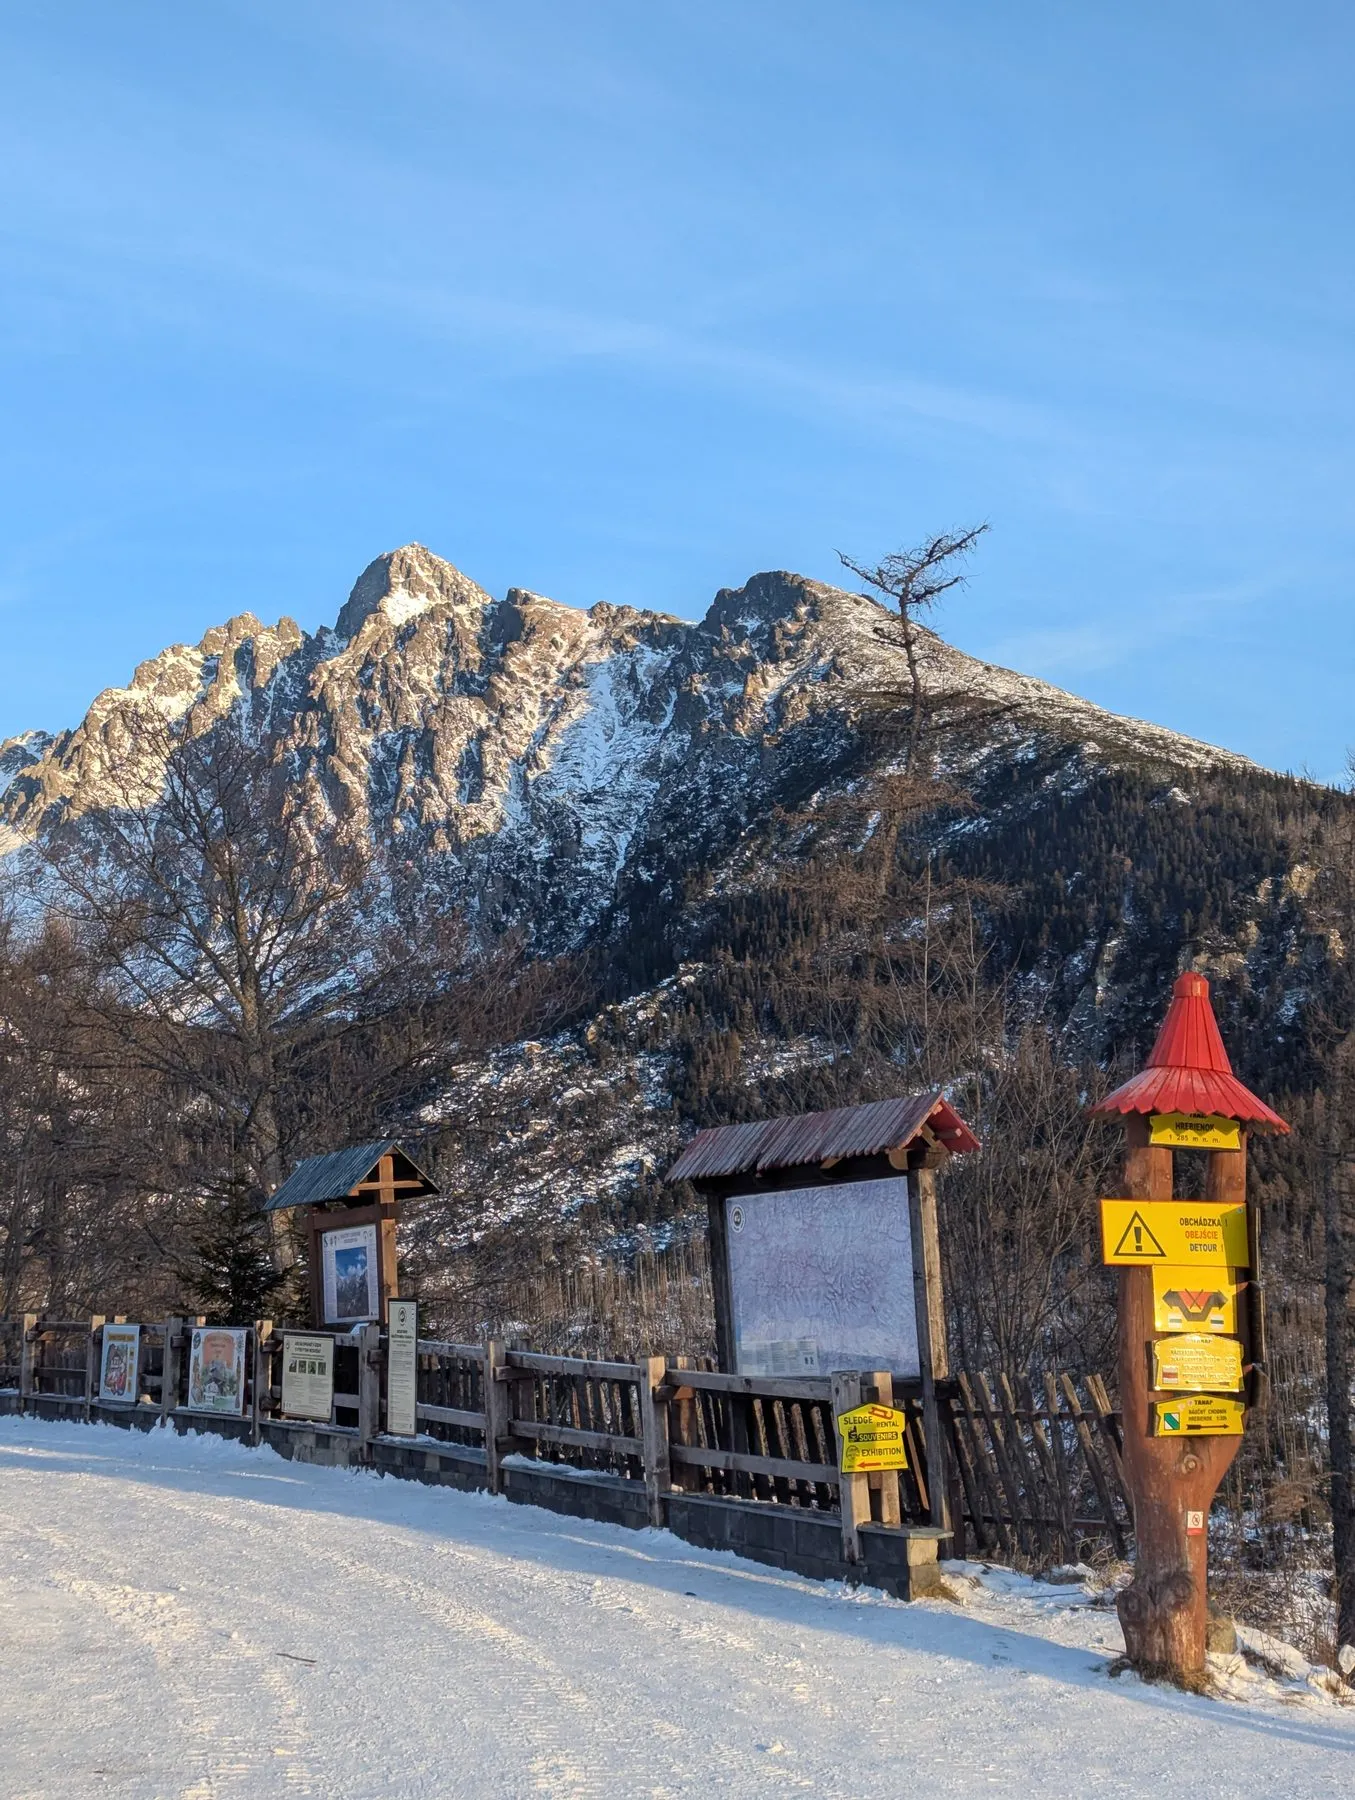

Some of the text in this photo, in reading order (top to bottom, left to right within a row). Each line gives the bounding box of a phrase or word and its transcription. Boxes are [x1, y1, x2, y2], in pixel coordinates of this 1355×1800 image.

[1177, 1134, 1188, 1142] 285
[1179, 1216, 1222, 1227] OBCHÁDZKA
[1185, 1229, 1218, 1239] OBEJŚCIE
[1189, 1243, 1217, 1252] DETOUR
[843, 1416, 873, 1425] SLEDGE
[859, 1433, 897, 1441] SOUVENIRS
[861, 1447, 901, 1456] EXHIBITION
